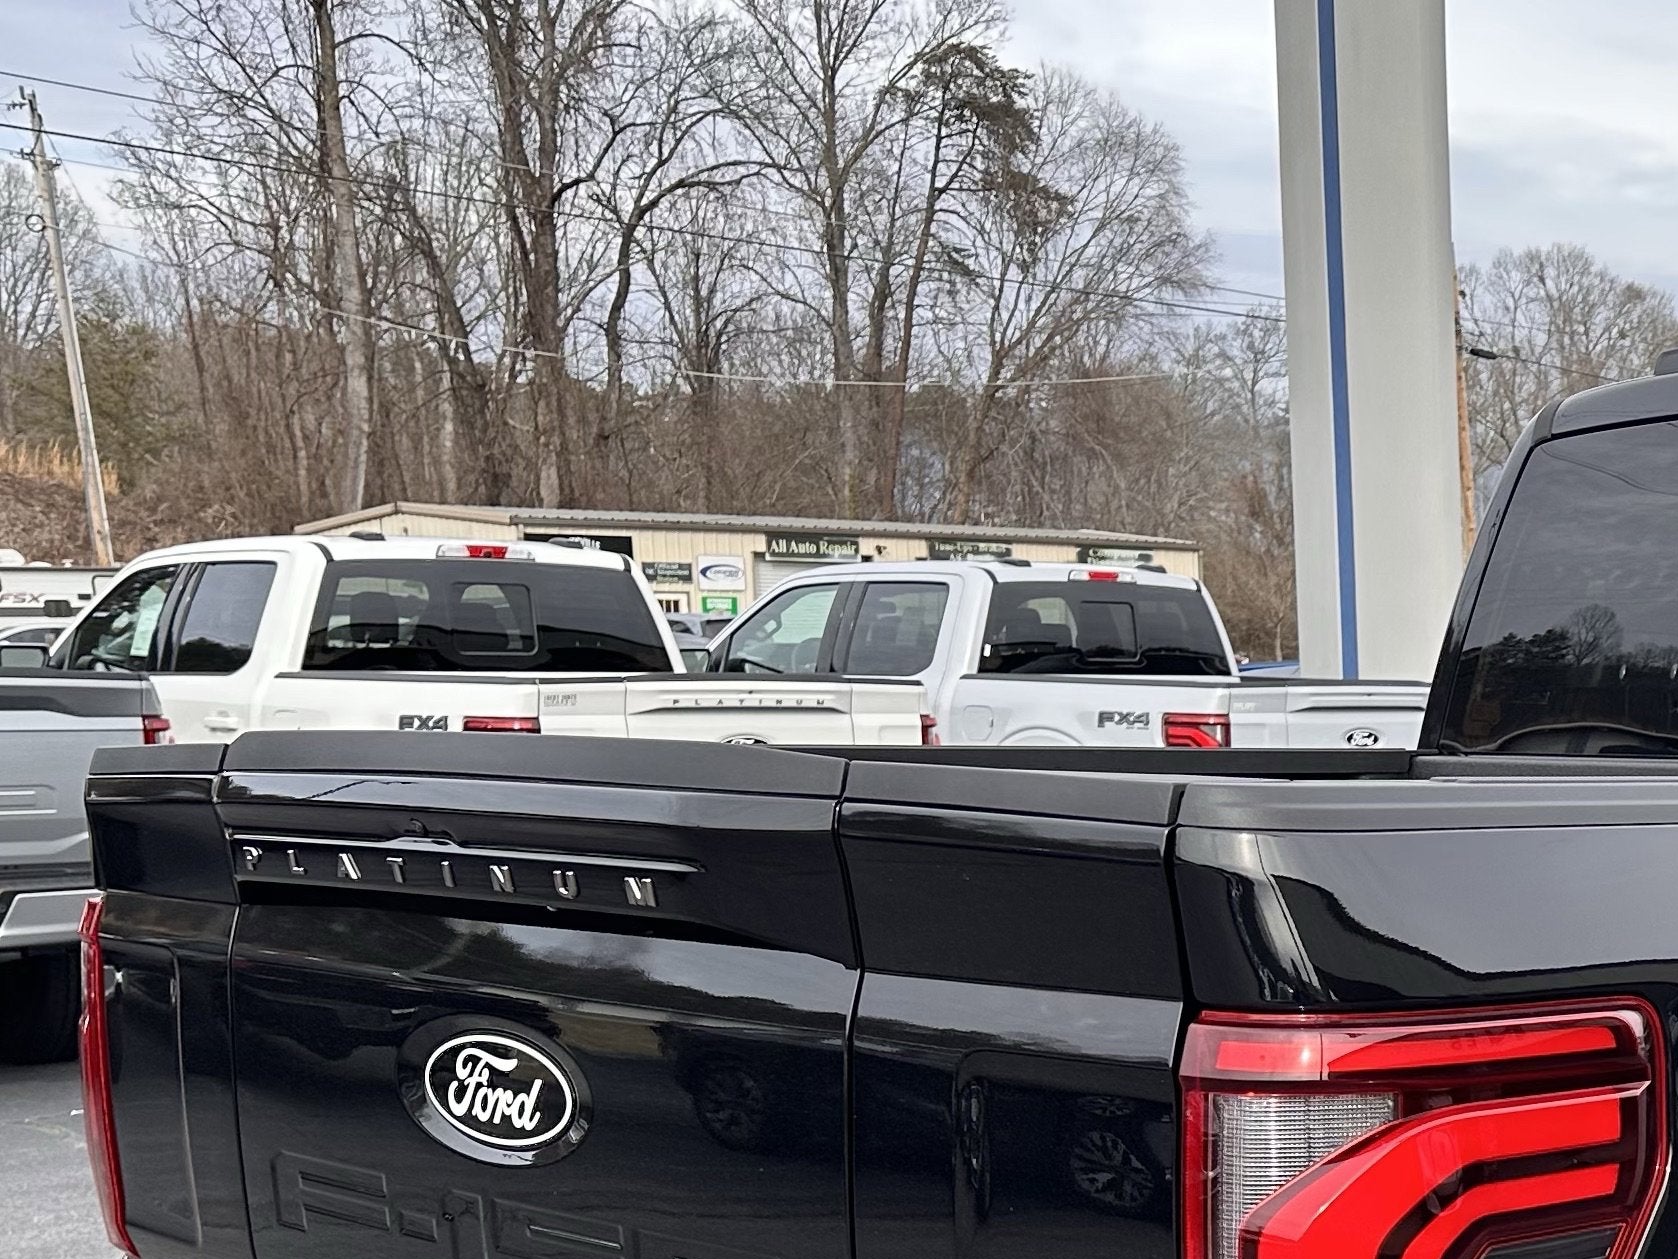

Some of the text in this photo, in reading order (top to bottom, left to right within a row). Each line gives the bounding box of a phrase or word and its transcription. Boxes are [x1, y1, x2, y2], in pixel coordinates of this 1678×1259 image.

[770, 539, 857, 558] All Auto Repair
[1097, 710, 1150, 728] FX4
[243, 846, 659, 908] PLATINUM
[448, 1047, 543, 1131] Ford
